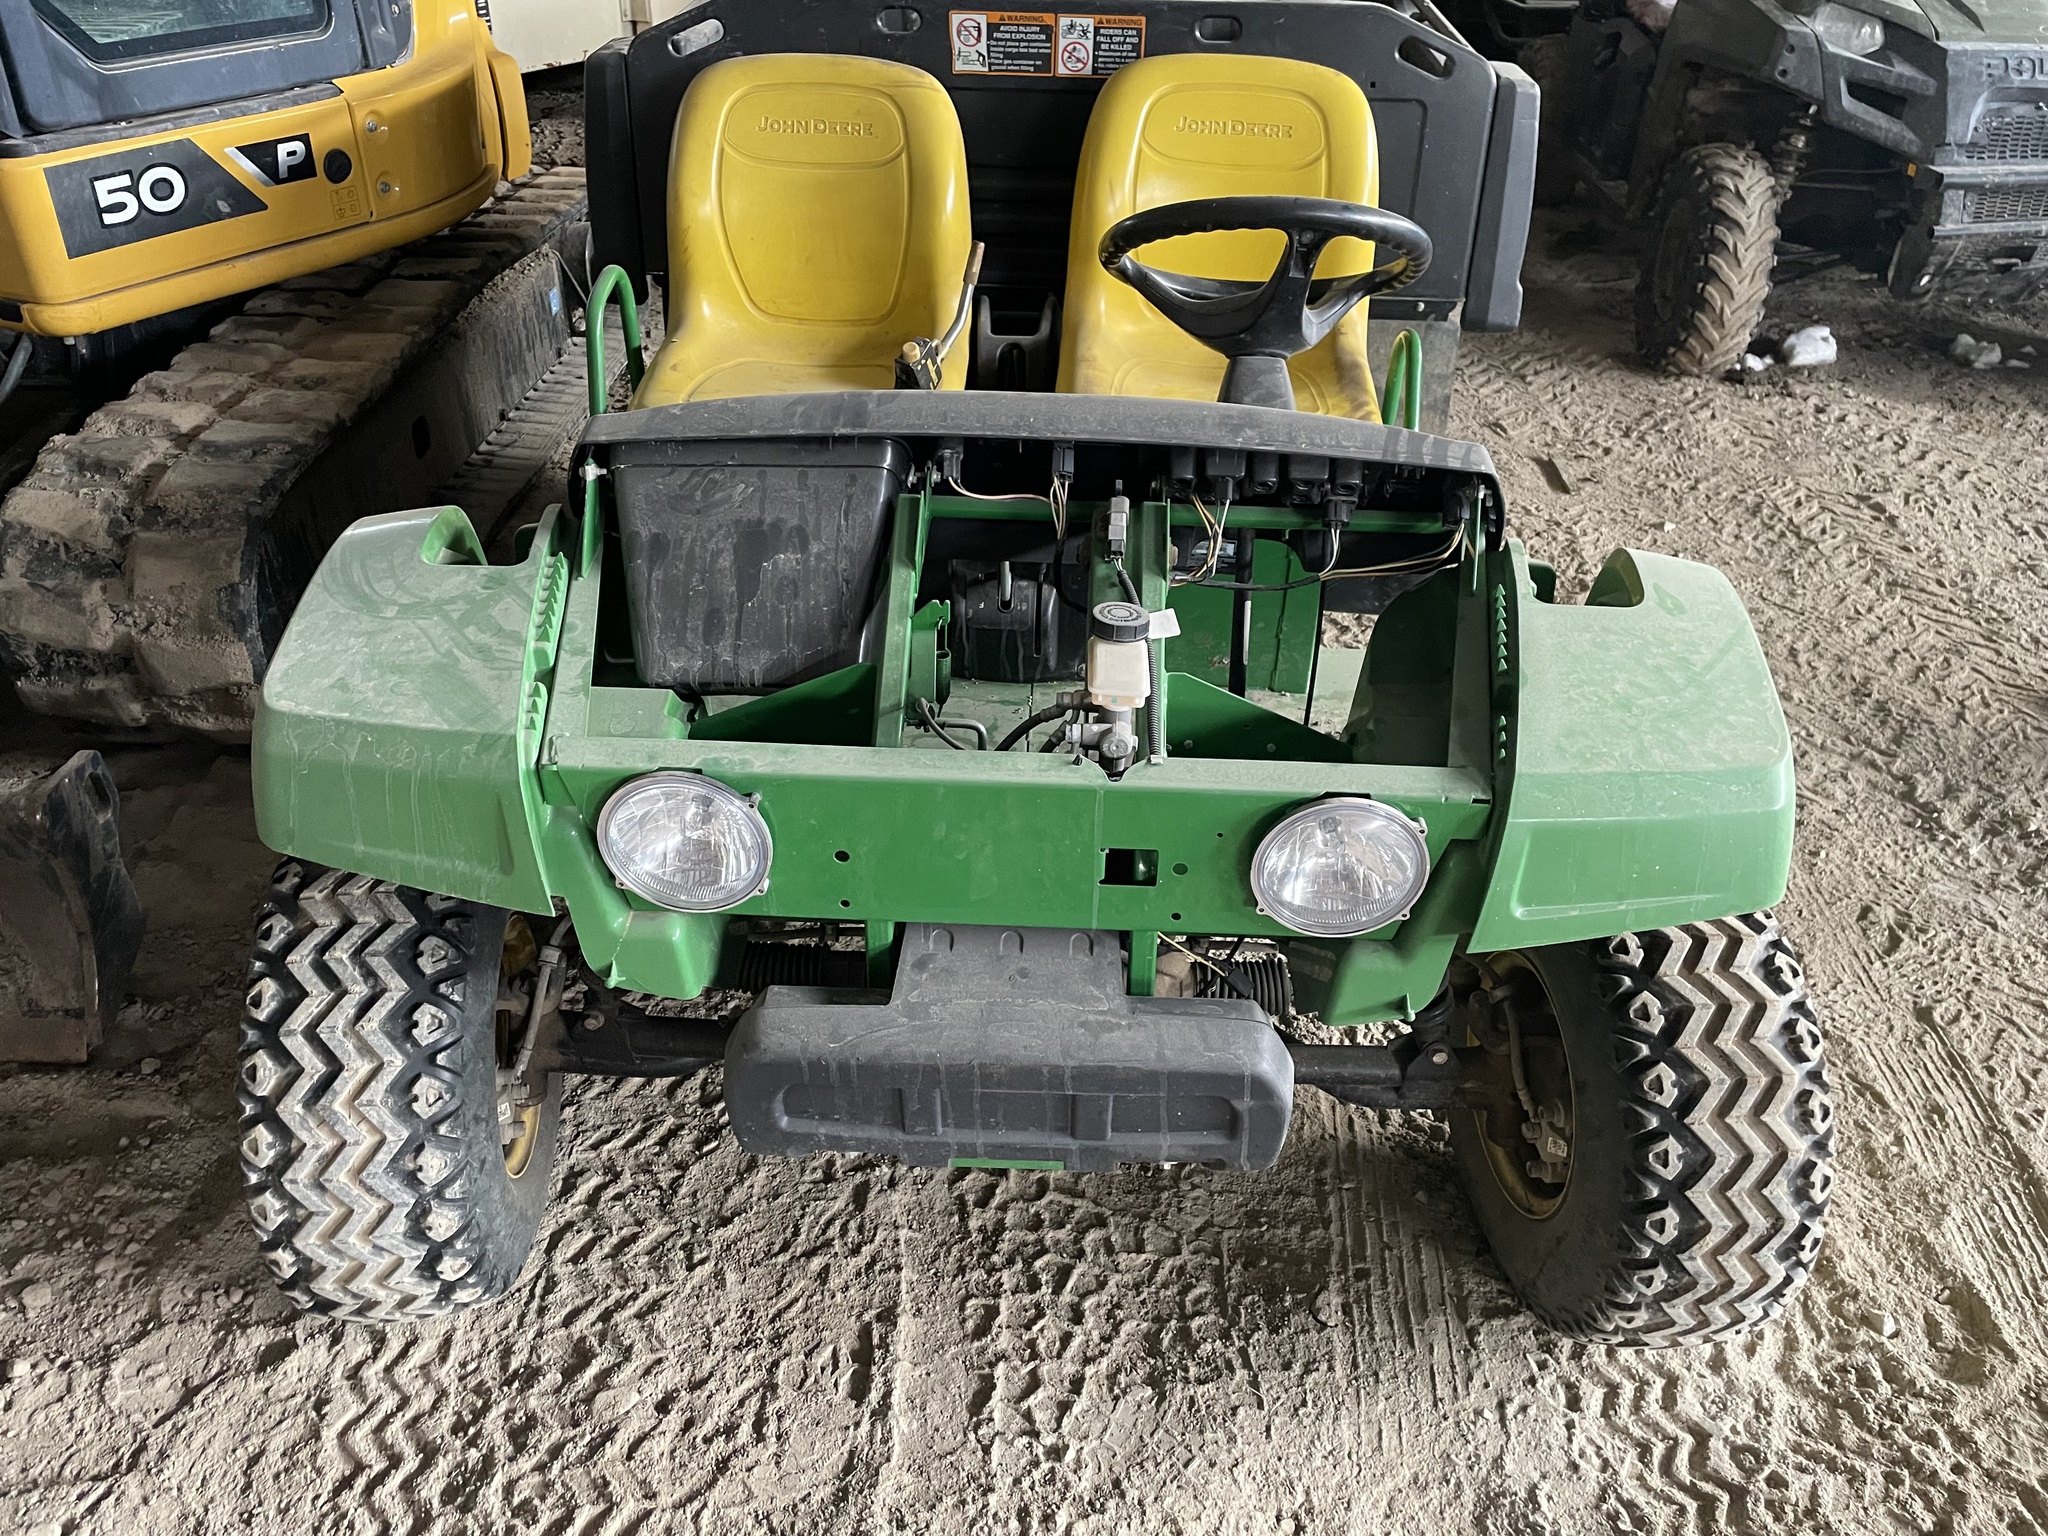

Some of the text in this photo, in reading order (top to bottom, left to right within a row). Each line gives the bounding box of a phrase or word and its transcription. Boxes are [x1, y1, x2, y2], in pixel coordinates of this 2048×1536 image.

[1007, 14, 1044, 23] WARNING
[1105, 17, 1142, 26] WARNING
[756, 116, 873, 136] JOHN DEERE
[1173, 116, 1293, 139] JOHN DEERE
[93, 166, 186, 225] 50
